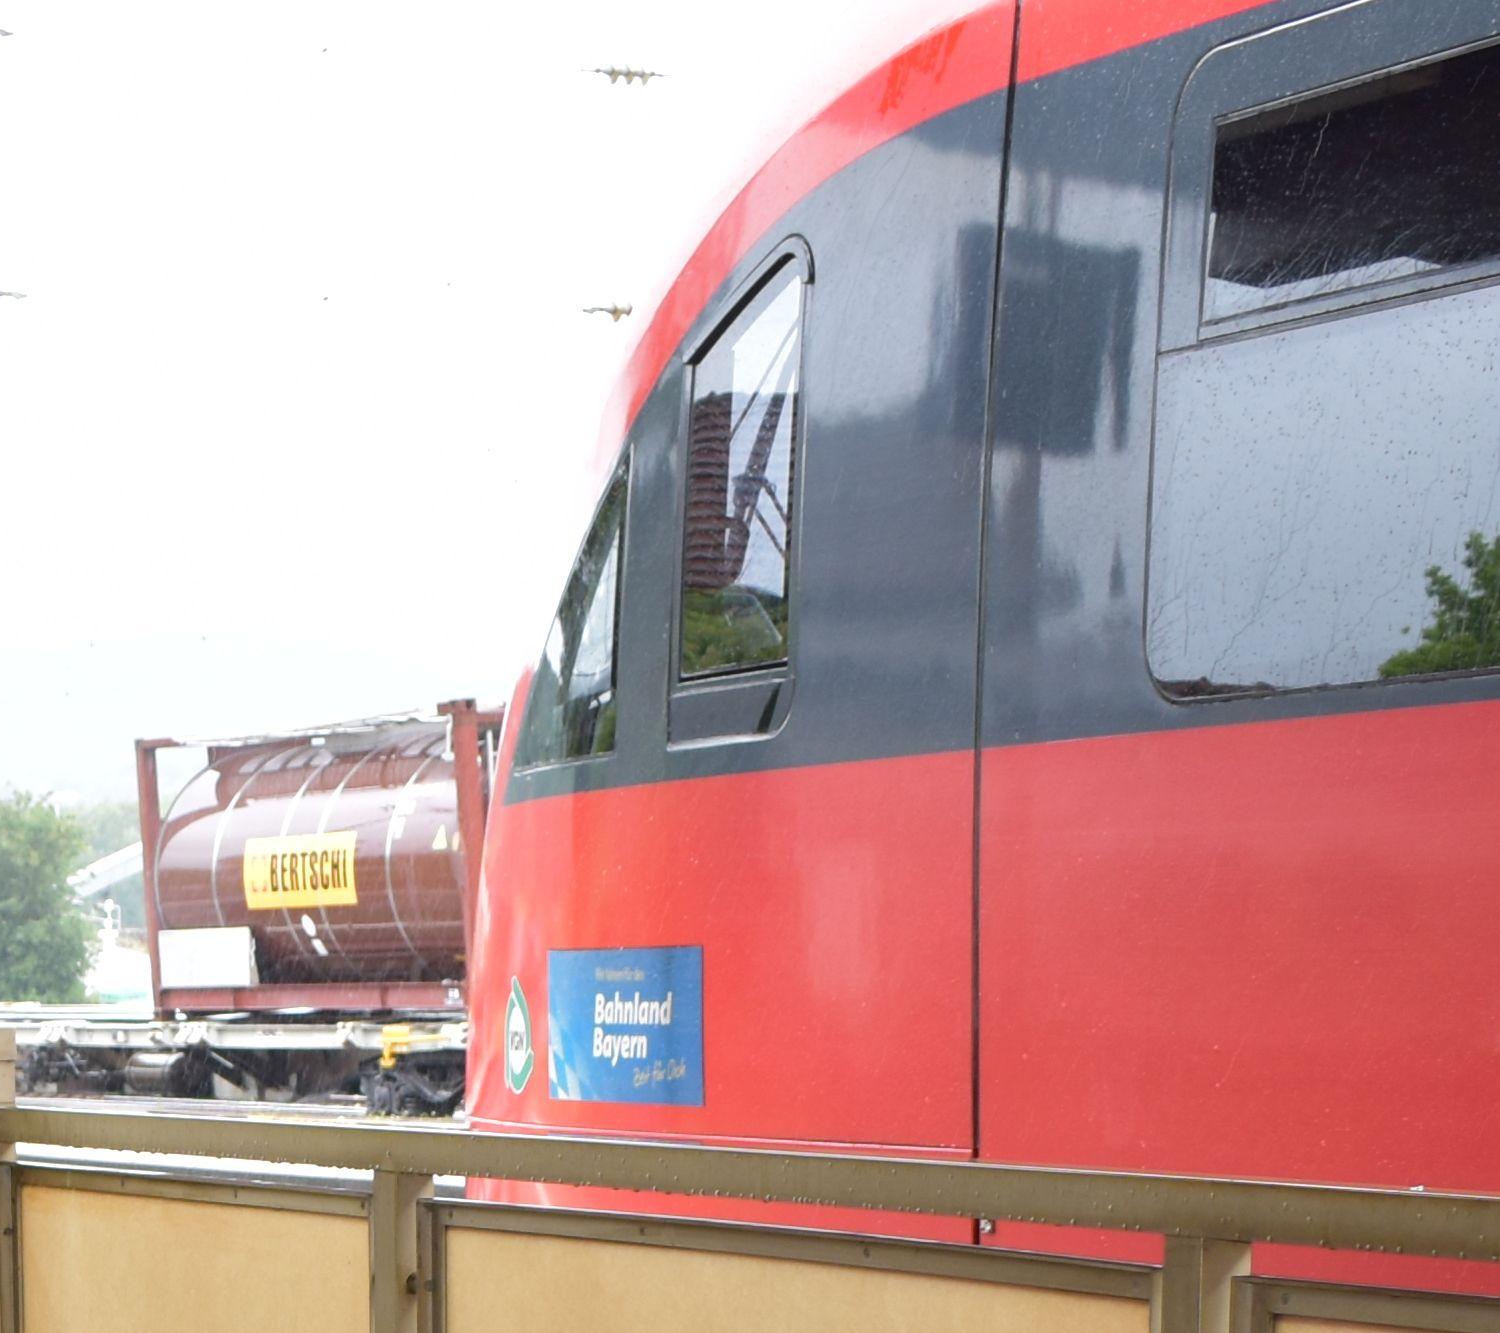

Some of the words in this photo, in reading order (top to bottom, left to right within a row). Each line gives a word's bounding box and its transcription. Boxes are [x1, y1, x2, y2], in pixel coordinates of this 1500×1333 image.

[269, 849, 348, 892] BERTSCHI
[594, 991, 673, 1026] Bahnland
[592, 1027, 648, 1068] Bayern
